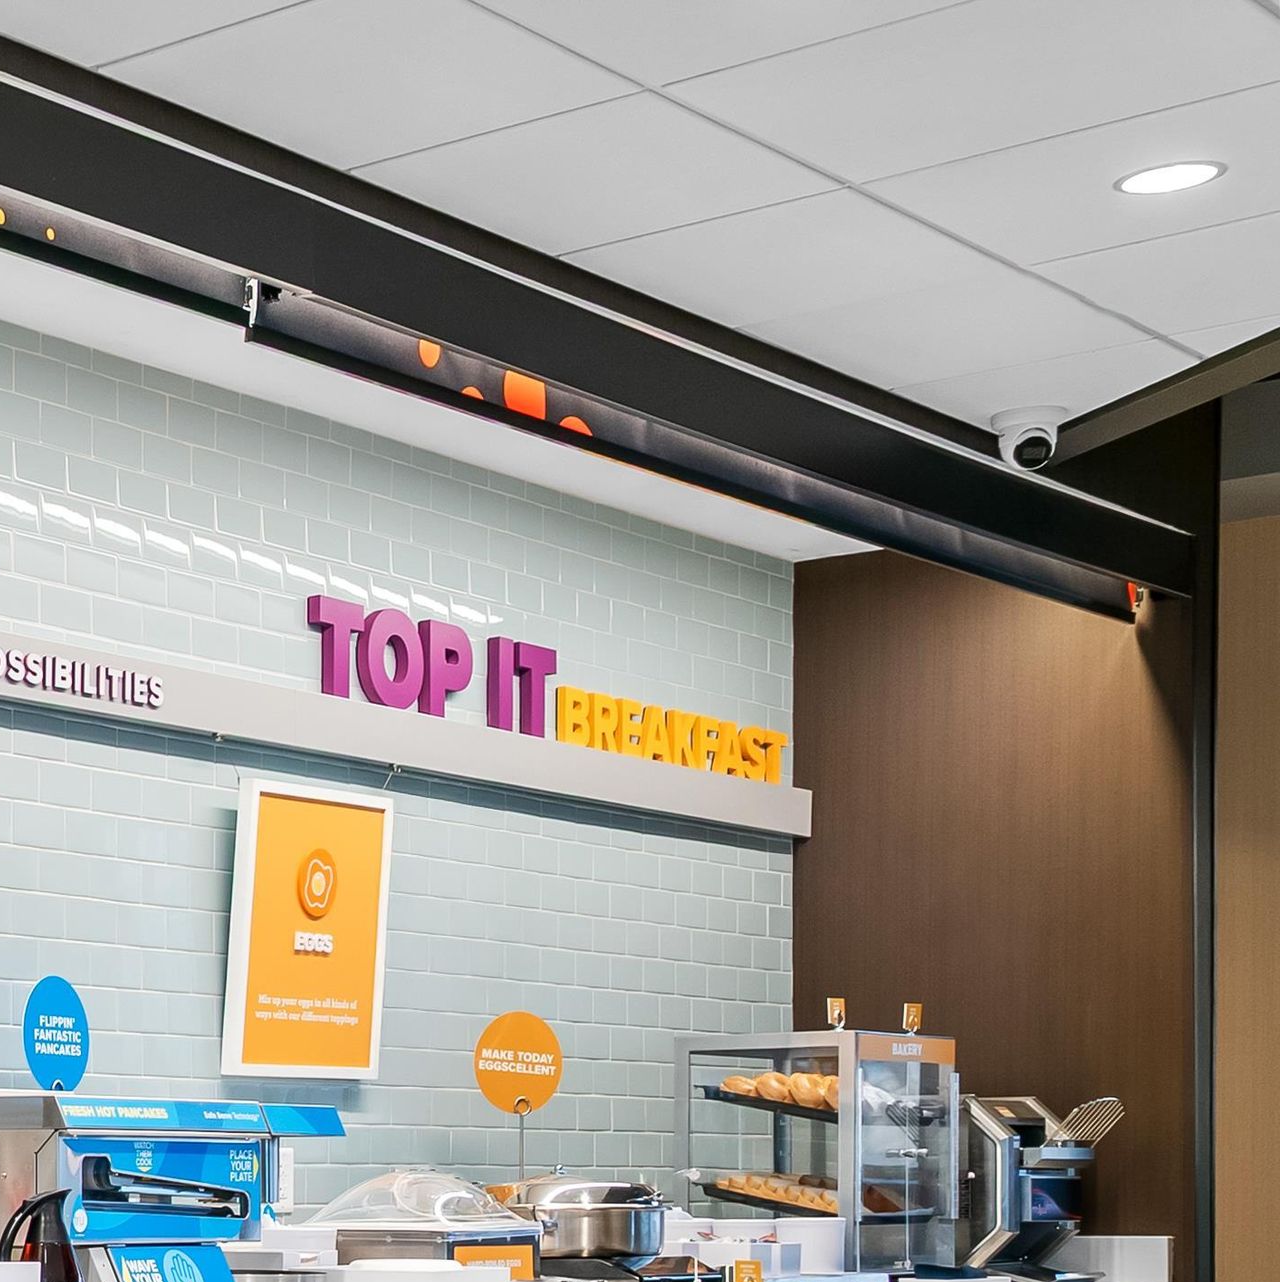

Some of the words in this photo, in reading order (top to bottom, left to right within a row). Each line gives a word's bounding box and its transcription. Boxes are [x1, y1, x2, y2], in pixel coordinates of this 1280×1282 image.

[307, 595, 474, 718] TOP
[486, 636, 558, 739] IT
[555, 685, 789, 785] BREAKFAST
[293, 930, 334, 954] EGGS
[271, 997, 281, 1007] up
[281, 998, 297, 1008] your
[297, 999, 314, 1010] eggs
[314, 998, 322, 1008] in
[322, 997, 331, 1008] all
[331, 997, 350, 1010] kinds
[350, 999, 358, 1010] of
[39, 1015, 76, 1029] FLIPPIN'
[255, 1011, 272, 1021] ways
[272, 1009, 288, 1020] with
[288, 1012, 300, 1021] our
[300, 1011, 330, 1023] different
[330, 1013, 359, 1026] toppings
[34, 1028, 82, 1043] FANTASTIC
[35, 1042, 82, 1057] PANCAKES
[481, 1048, 515, 1061] MAKE
[517, 1051, 555, 1065] TODAY
[892, 1043, 924, 1056] BAKERY
[478, 1059, 557, 1077] EGGSCELLENT
[62, 1105, 96, 1117] FRESH
[95, 1106, 117, 1118] HOT
[117, 1107, 169, 1120] PANCAKES
[229, 1149, 253, 1160] PLACE
[135, 1158, 153, 1166] COOK
[230, 1160, 252, 1171] YOUR
[230, 1171, 253, 1182] PLATE
[126, 1259, 160, 1272] WAVE
